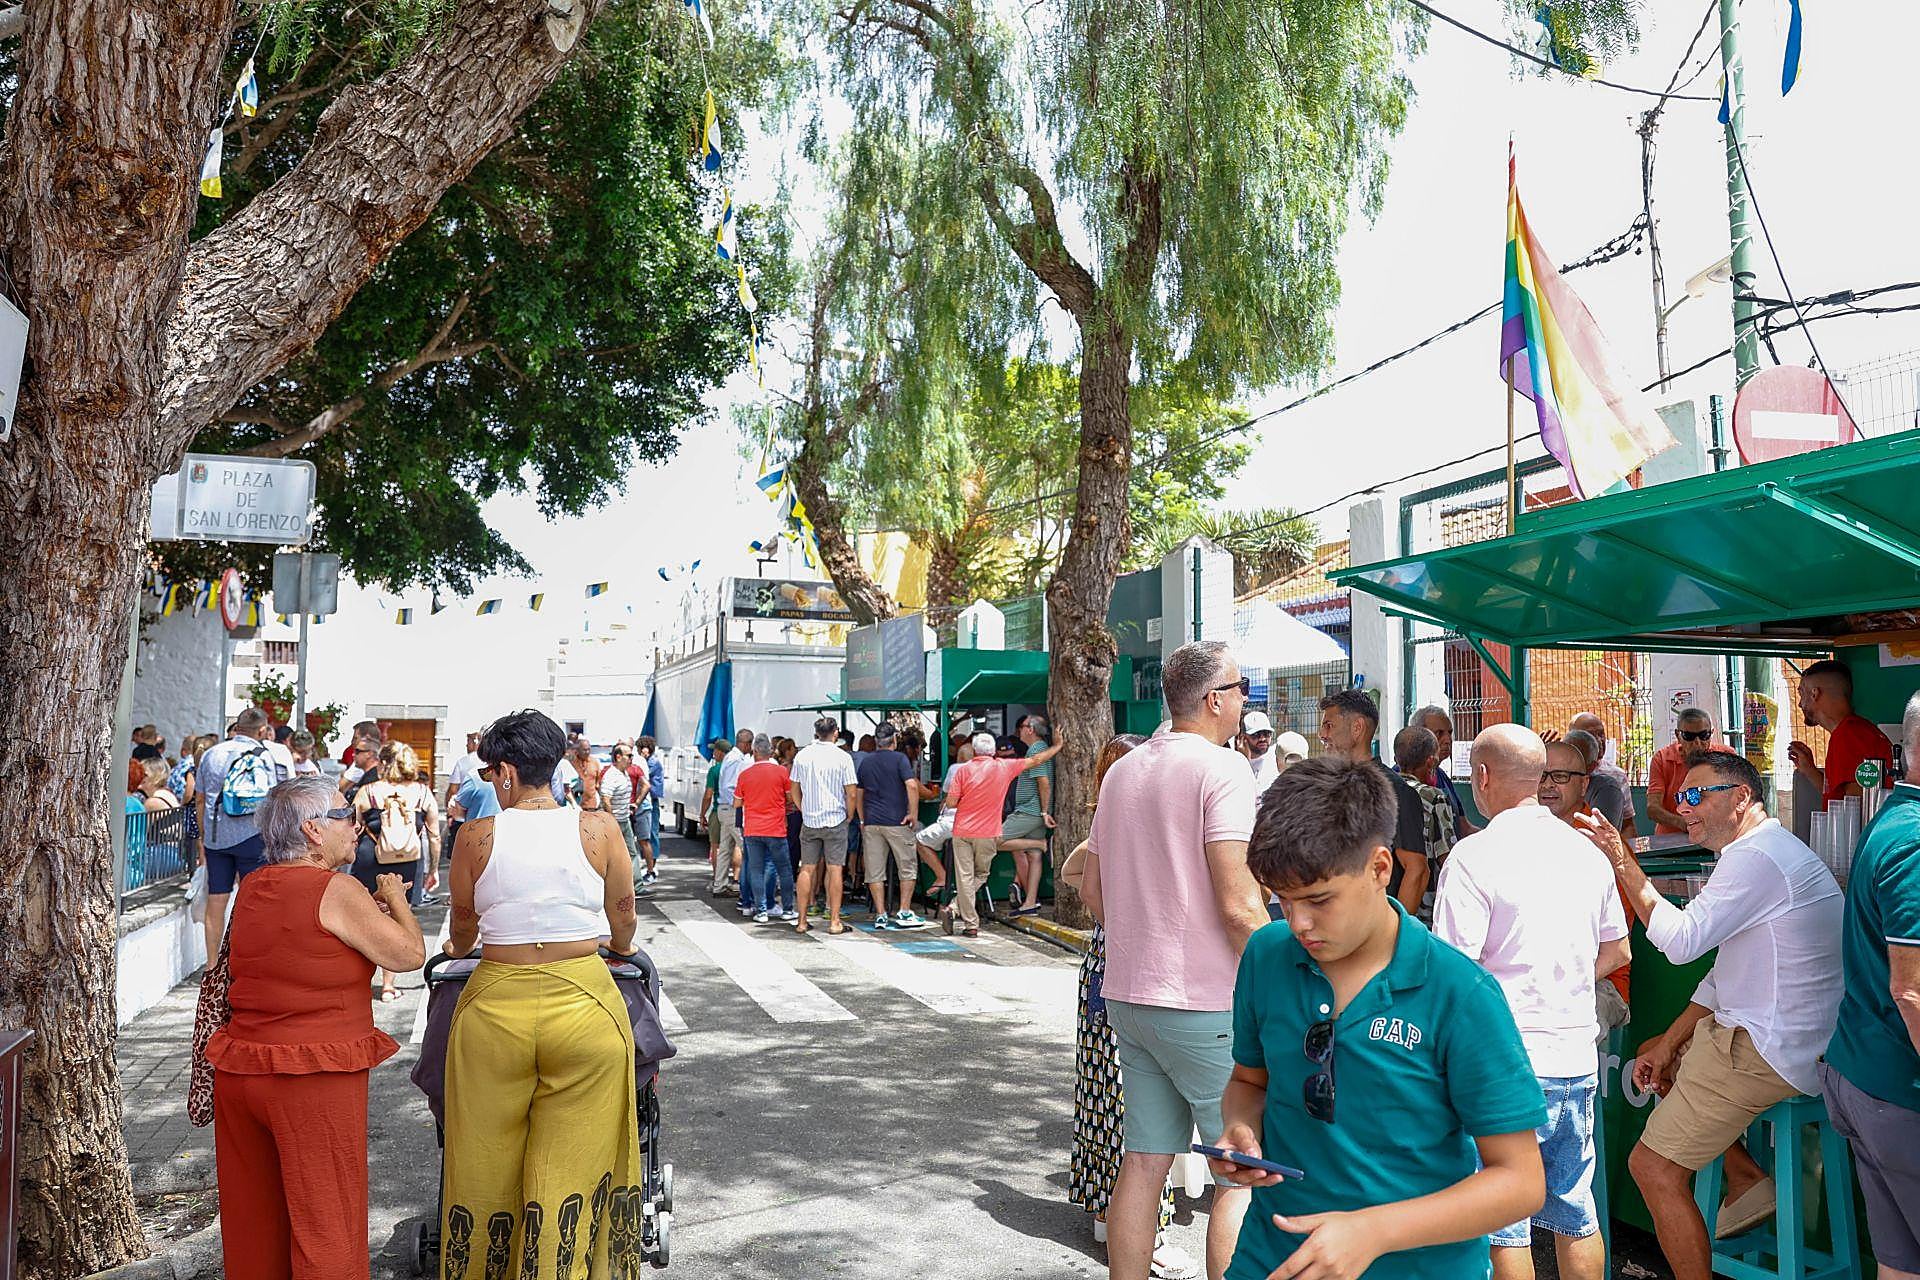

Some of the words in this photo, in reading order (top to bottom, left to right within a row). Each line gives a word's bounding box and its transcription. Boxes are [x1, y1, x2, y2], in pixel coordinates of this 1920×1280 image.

[223, 470, 273, 488] PLAZA
[236, 492, 257, 508] DE
[189, 509, 221, 527] SAN
[227, 511, 301, 532] LORENZO
[780, 610, 804, 618] PAPAS
[1369, 1017, 1422, 1050] GAP
